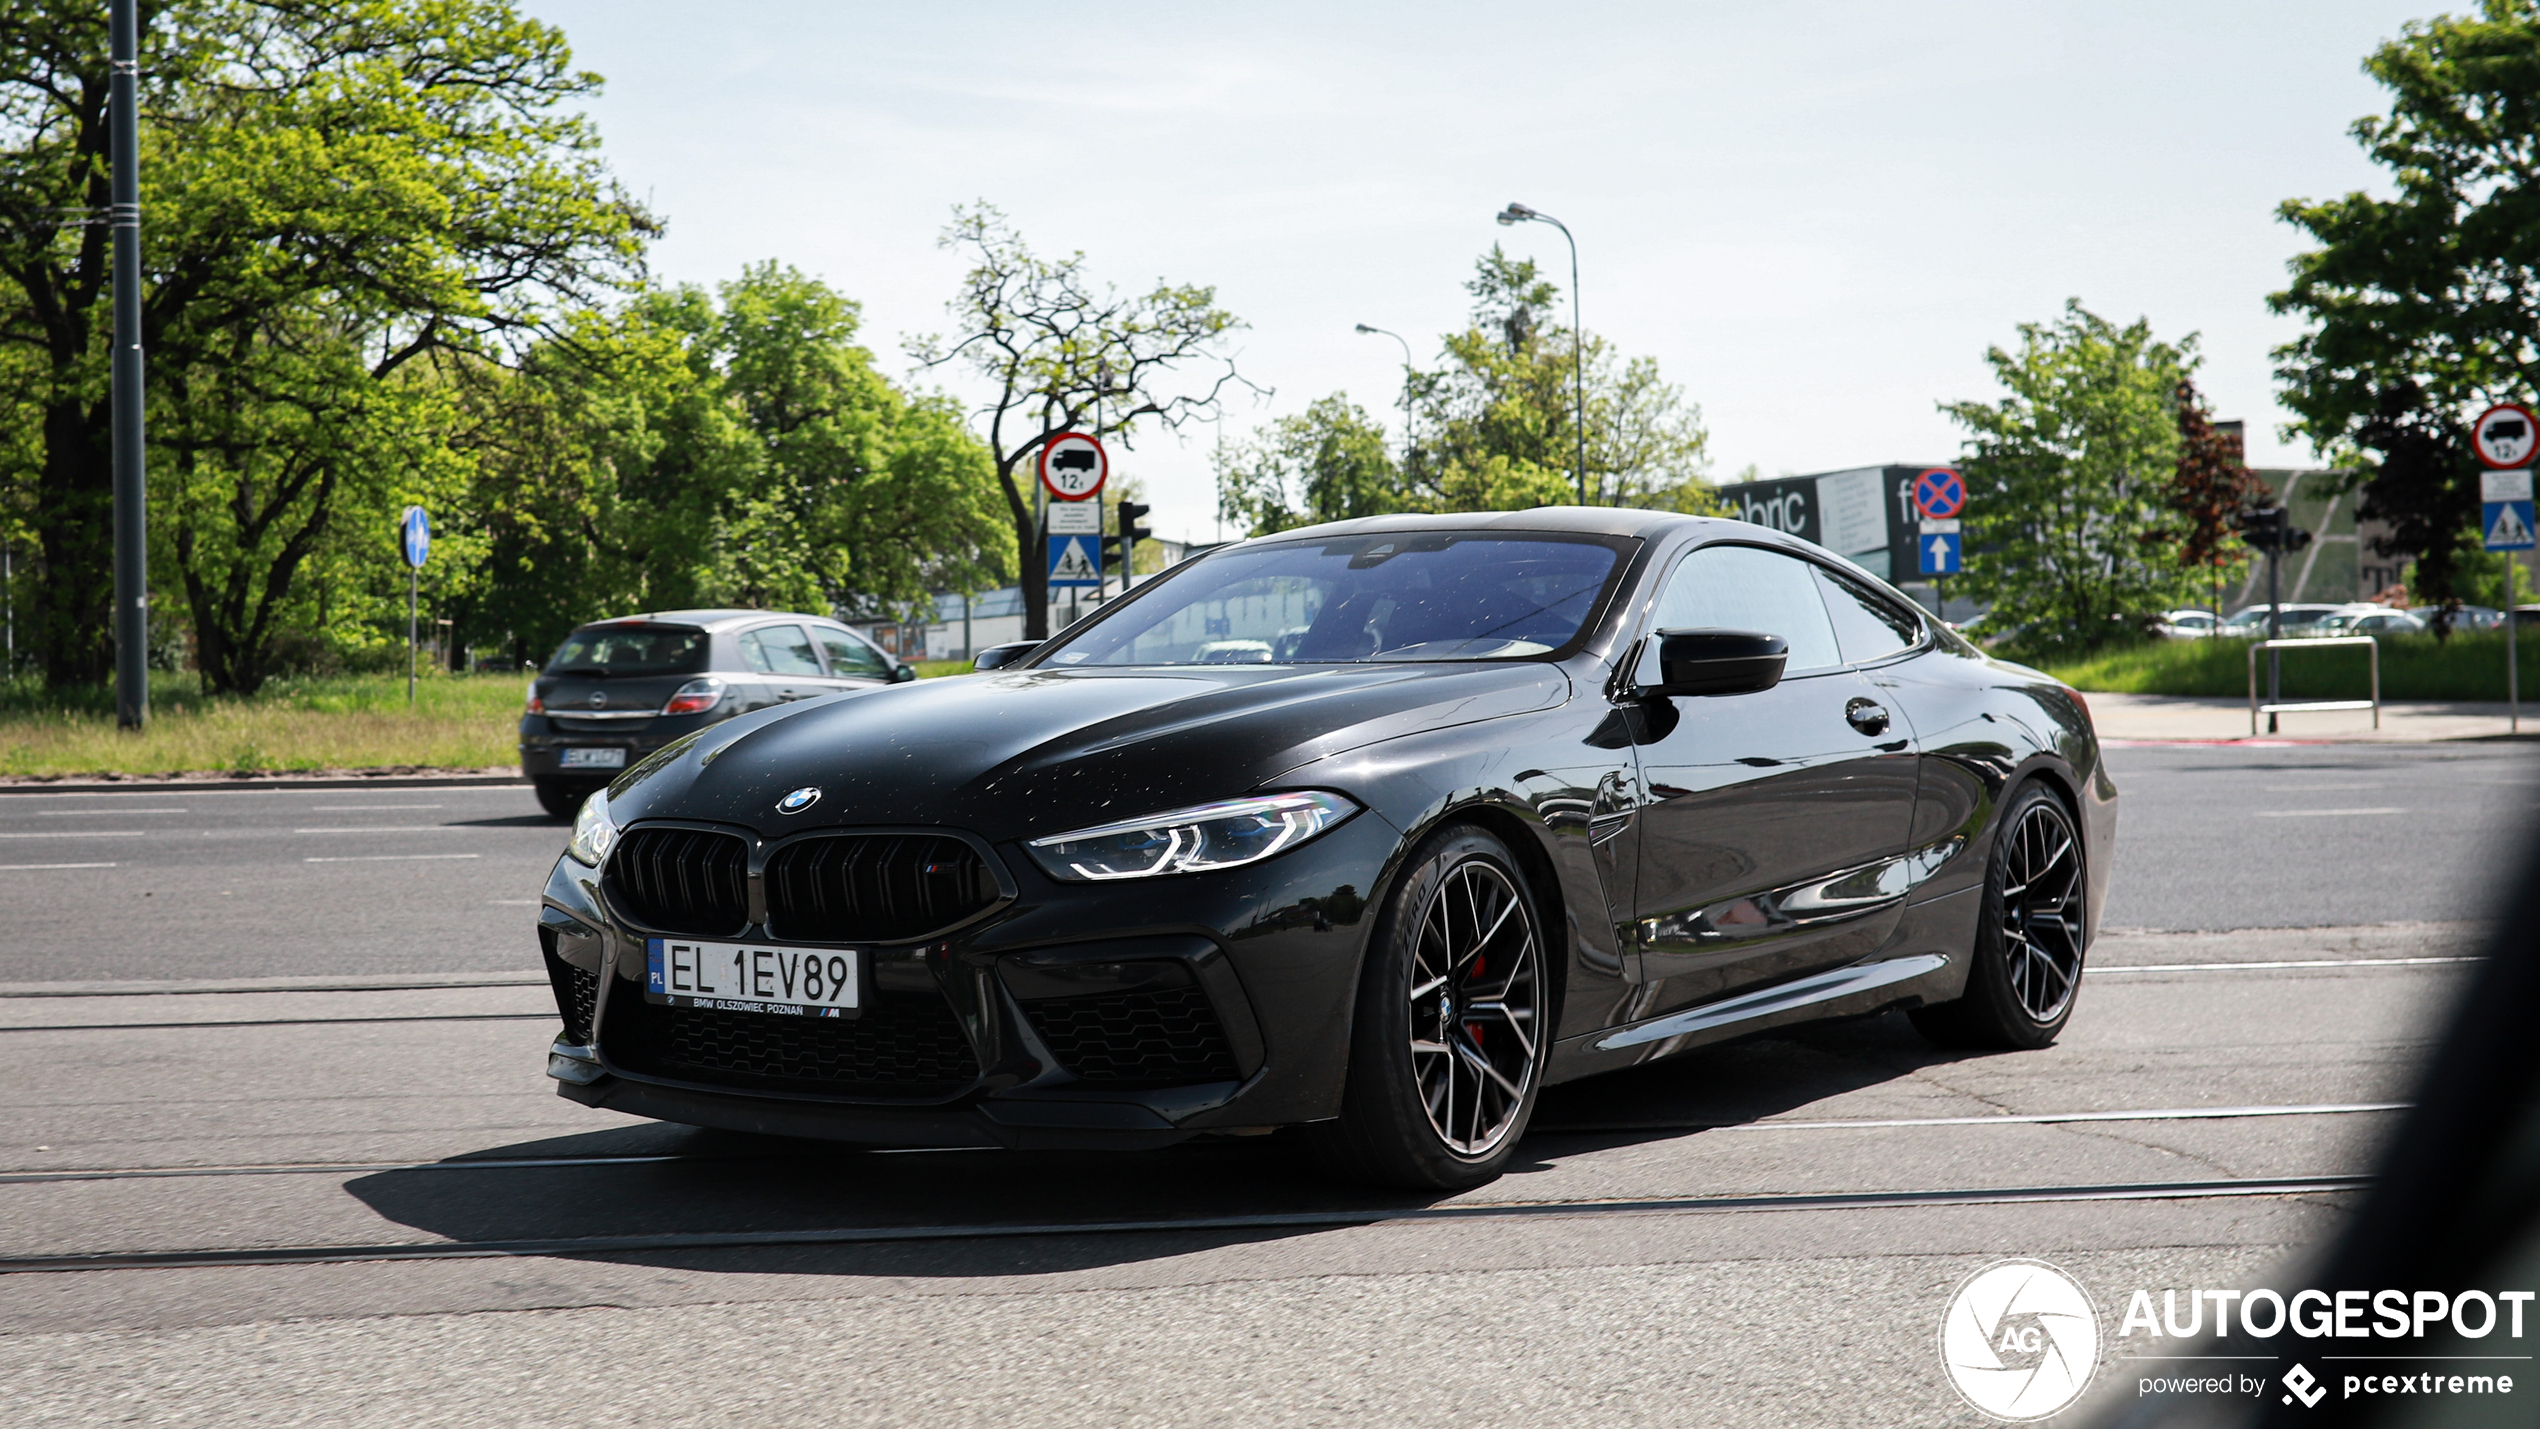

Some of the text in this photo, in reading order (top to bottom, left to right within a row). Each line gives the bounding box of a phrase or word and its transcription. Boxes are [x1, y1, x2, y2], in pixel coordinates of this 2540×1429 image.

[1403, 883, 1427, 956] ZERO
[651, 972, 663, 985] PL
[672, 945, 847, 1002] EL 1EV89
[694, 998, 714, 1008] BMW
[717, 999, 764, 1012] OLSZOWIEC
[767, 1003, 803, 1015] POZNAŃ
